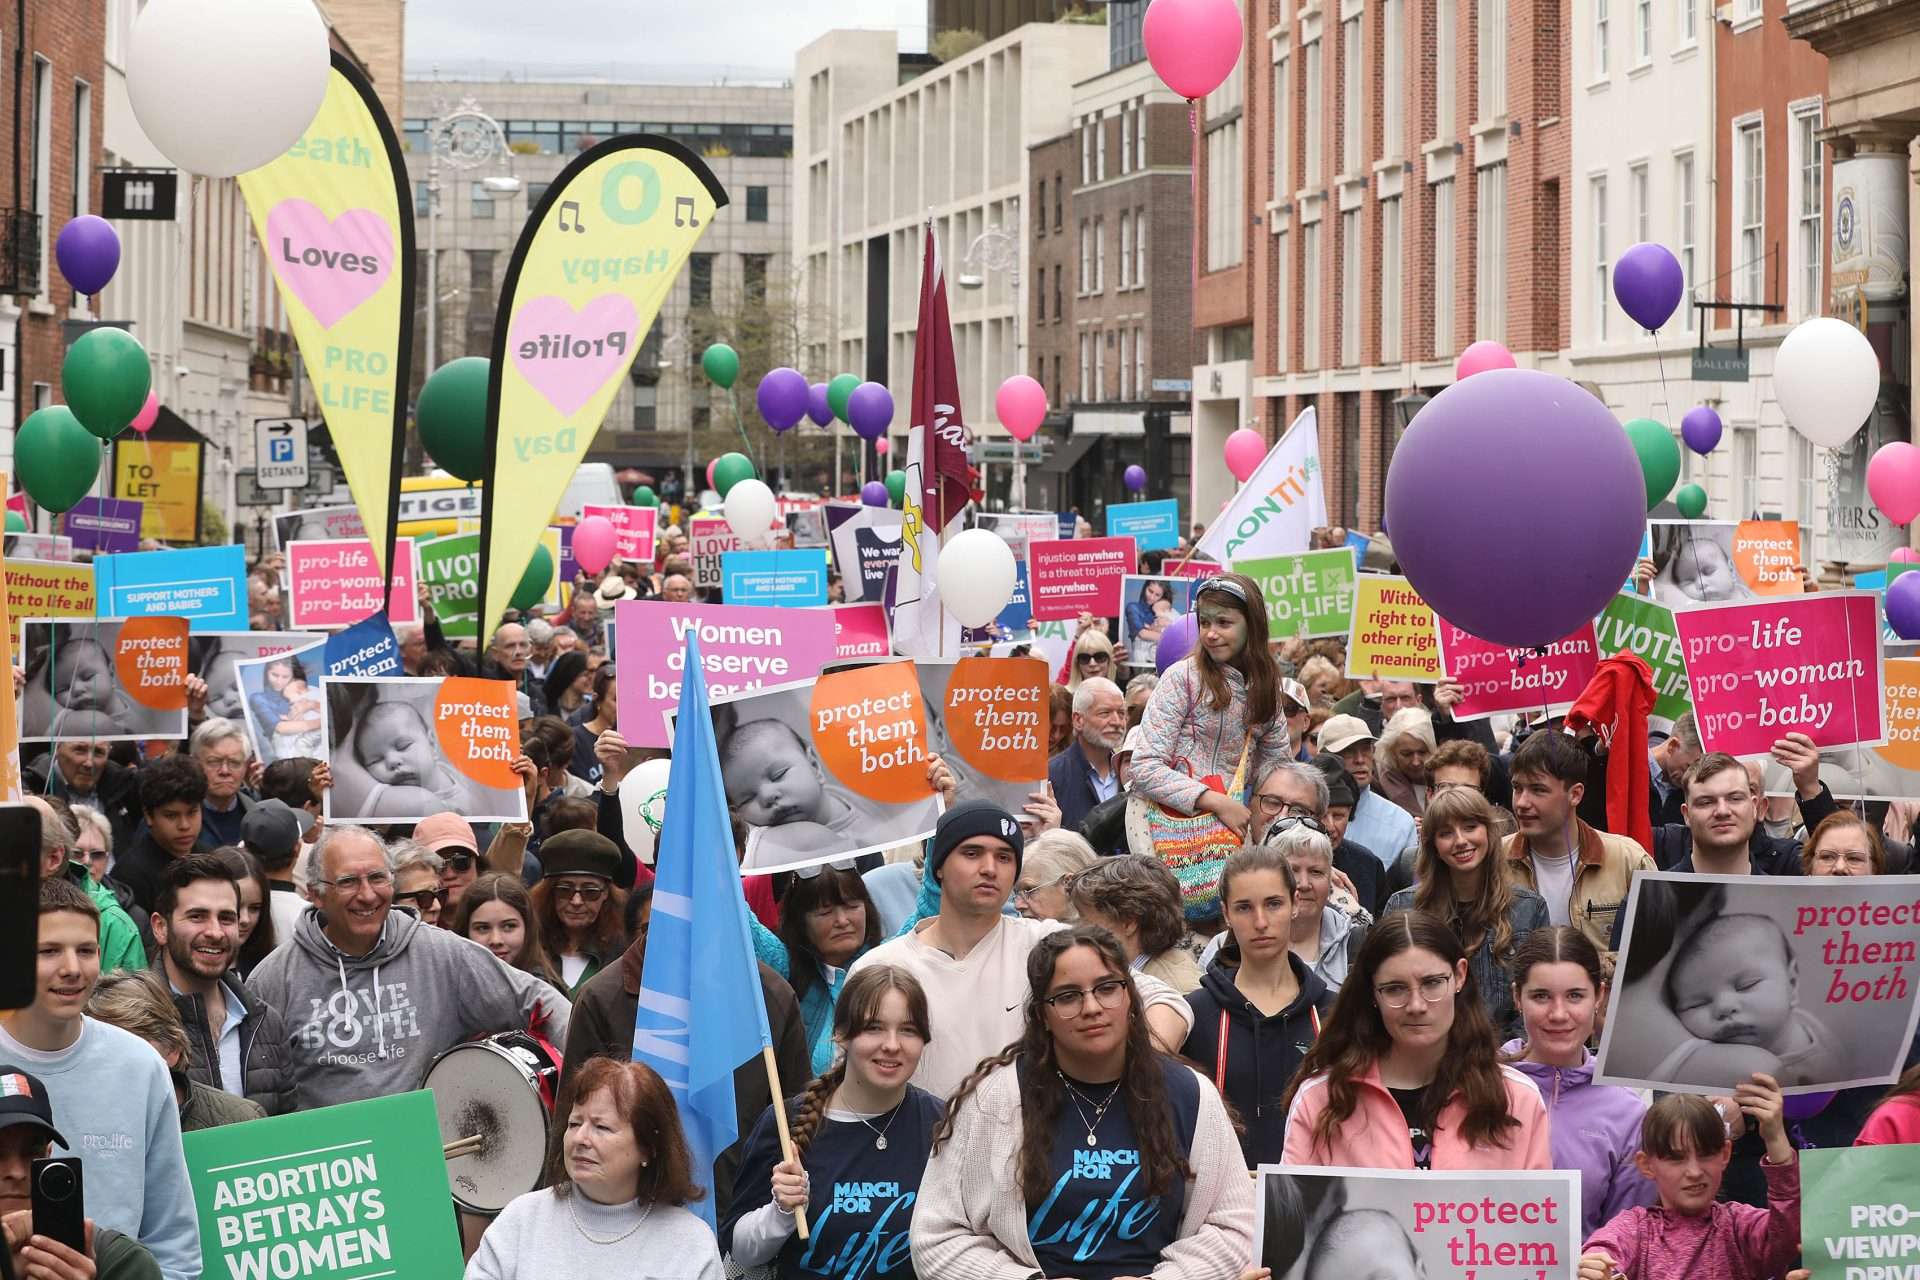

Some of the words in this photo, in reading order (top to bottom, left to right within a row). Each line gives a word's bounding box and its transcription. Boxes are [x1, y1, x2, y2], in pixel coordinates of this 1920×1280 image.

[283, 237, 379, 275] Loves
[325, 346, 389, 375] PRO
[1693, 359, 1747, 369] GALLERY
[322, 383, 390, 415] LIFE
[274, 441, 291, 461] P
[128, 464, 153, 479] TO
[261, 466, 305, 478] SETANTA
[127, 483, 160, 497] LET
[861, 547, 881, 558] We
[1736, 536, 1793, 552] protect
[298, 550, 369, 573] pro-life
[1038, 552, 1076, 565] injustice
[1077, 549, 1124, 562] anywhere
[1753, 550, 1794, 566] them
[427, 560, 436, 582] I
[864, 569, 884, 580] live
[1039, 567, 1047, 578] is
[1056, 567, 1083, 577] threat
[1085, 567, 1096, 577] to
[1096, 564, 1128, 578] justice
[1758, 567, 1797, 582] both
[64, 577, 89, 592] the
[127, 590, 172, 603] SUPPORT
[173, 586, 220, 600] MOTHERS
[431, 579, 478, 604] PRO
[1039, 581, 1098, 595] everywhere.
[1253, 571, 1318, 597] VOTE
[28, 592, 43, 607] to
[75, 597, 94, 611] all
[145, 601, 166, 613] AND
[168, 599, 203, 611] BABIES
[300, 593, 385, 616] pro-baby
[1369, 611, 1408, 629] right
[1410, 613, 1427, 628] to
[669, 615, 782, 647] Women
[1361, 633, 1404, 646] other
[1688, 616, 1802, 664] pro-life
[120, 635, 182, 655] protect
[1613, 618, 1683, 668] VOTE
[136, 653, 182, 669] them
[329, 635, 393, 677] protect
[666, 647, 788, 676] dserve
[140, 670, 182, 688] both
[648, 674, 740, 700] beer
[1695, 656, 1865, 702] pro-woman
[950, 685, 1041, 706] protect
[438, 700, 511, 721] protect
[816, 690, 913, 732] protect
[974, 705, 1040, 727] them
[1704, 694, 1834, 740] pro-baby
[460, 719, 511, 740] them
[847, 716, 919, 749] them
[980, 727, 1040, 751] both
[467, 740, 513, 761] both
[861, 739, 925, 774] both
[1793, 899, 1920, 935] protect
[1822, 930, 1915, 966] them
[1824, 966, 1907, 1004] both
[317, 1050, 377, 1066] choose
[1073, 1148, 1140, 1166] MARCH
[213, 1153, 378, 1211] ABORTION
[1073, 1164, 1112, 1180] FOR
[833, 1181, 899, 1199] MARCH
[833, 1197, 872, 1214] FOR
[1032, 1164, 1161, 1262] Life
[1413, 1195, 1559, 1232] protect
[217, 1188, 386, 1248] BETRAYS
[1850, 1204, 1920, 1229] PRO-
[224, 1224, 391, 1280] WOMEN
[1447, 1229, 1559, 1266] them
[1824, 1234, 1920, 1260] VIEWP
[1845, 1264, 1920, 1280] DRIV
